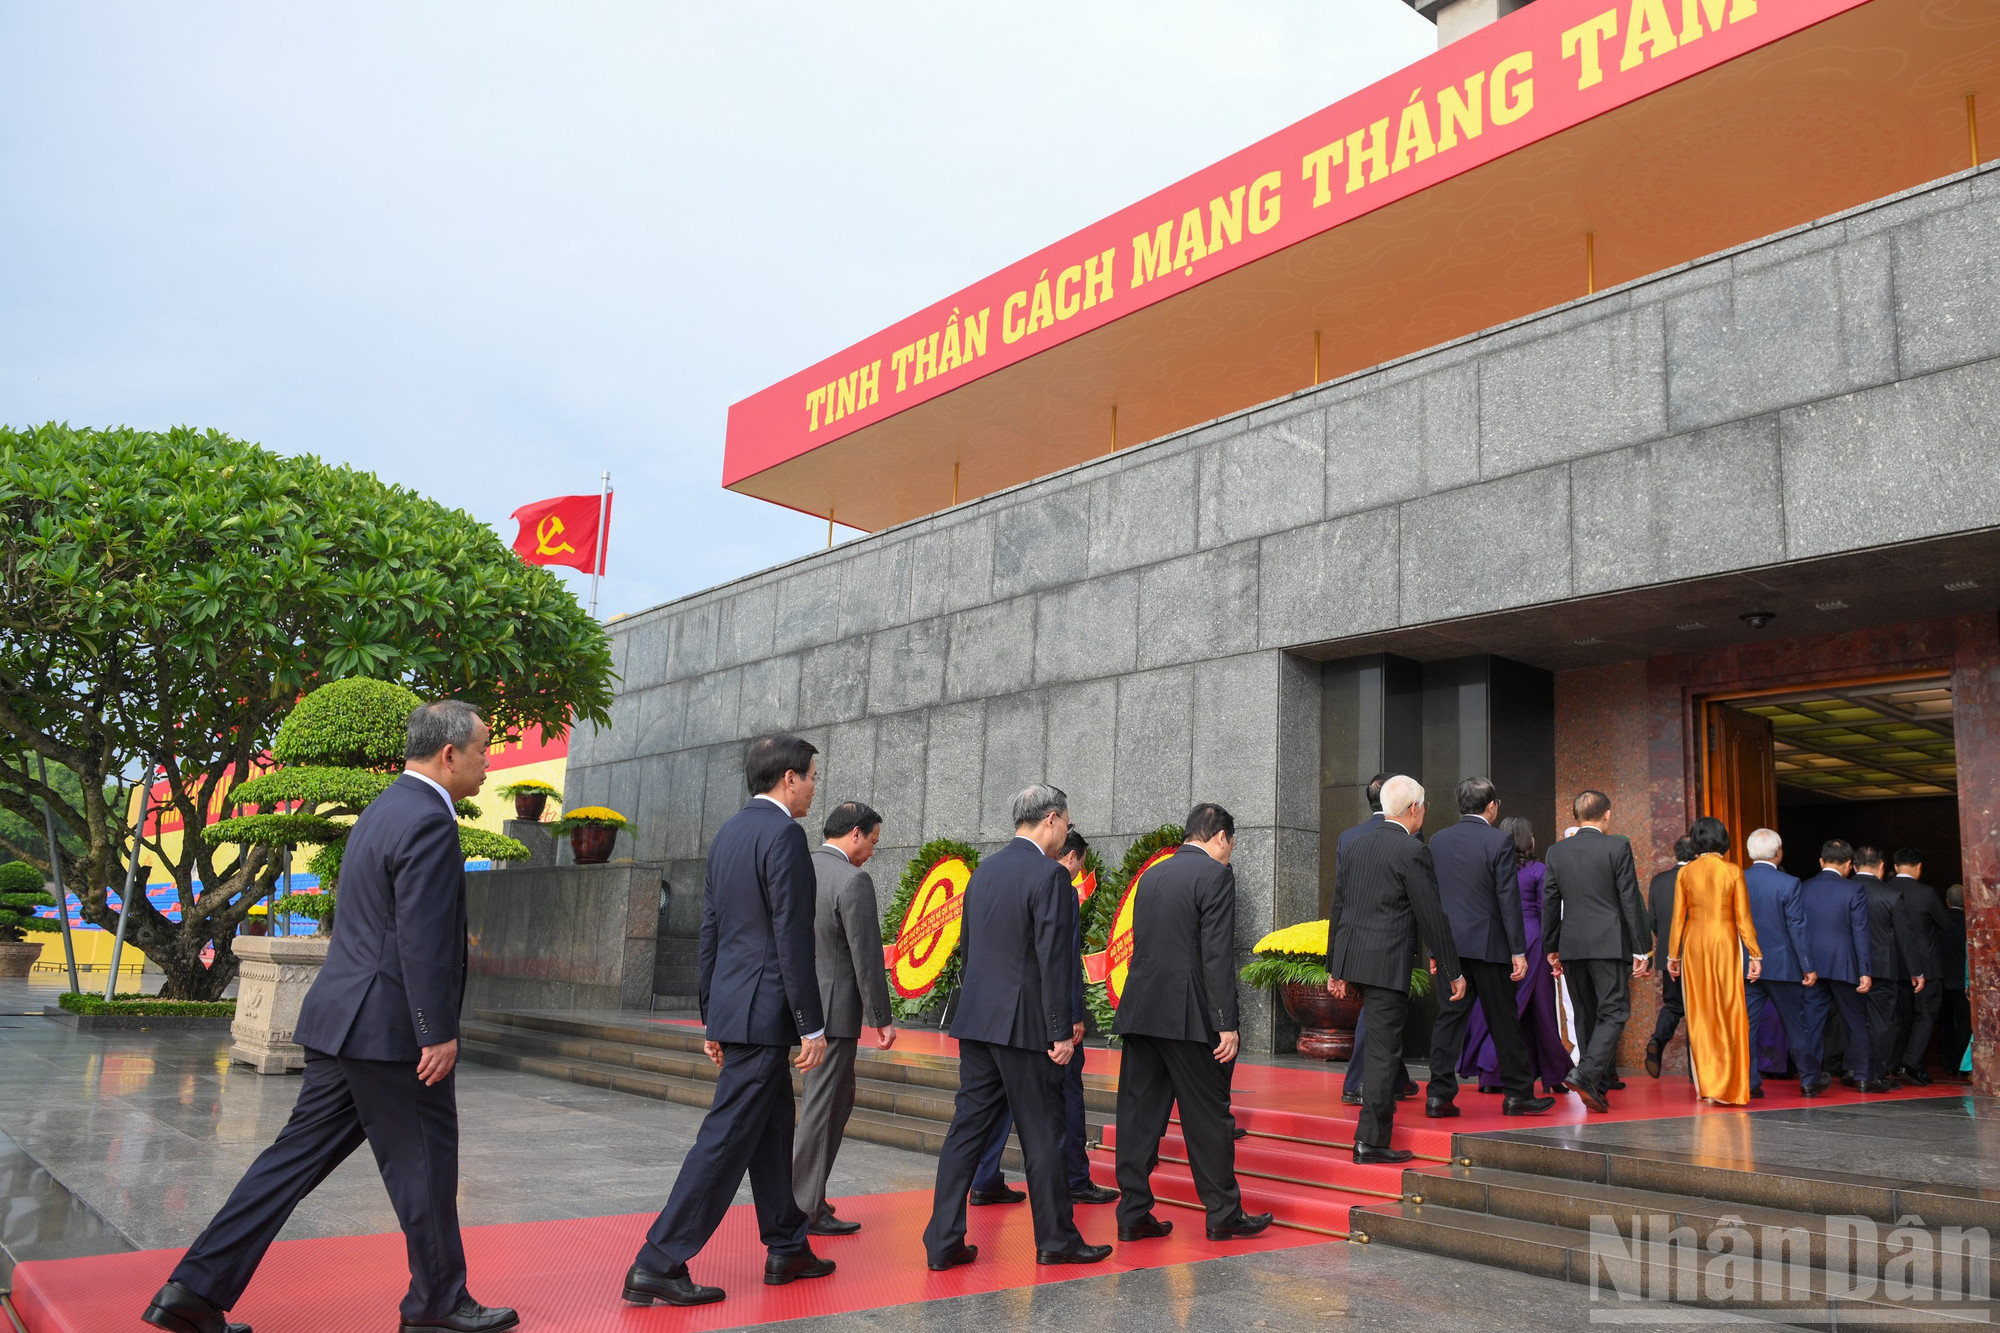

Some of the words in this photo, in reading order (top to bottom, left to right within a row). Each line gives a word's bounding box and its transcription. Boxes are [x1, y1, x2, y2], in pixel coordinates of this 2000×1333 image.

[804, 358, 882, 434] TINH
[890, 305, 990, 395] THẦN
[1001, 246, 1116, 346] CÁCH
[1129, 169, 1283, 290] MẠNG
[1301, 49, 1535, 210] THÁNG
